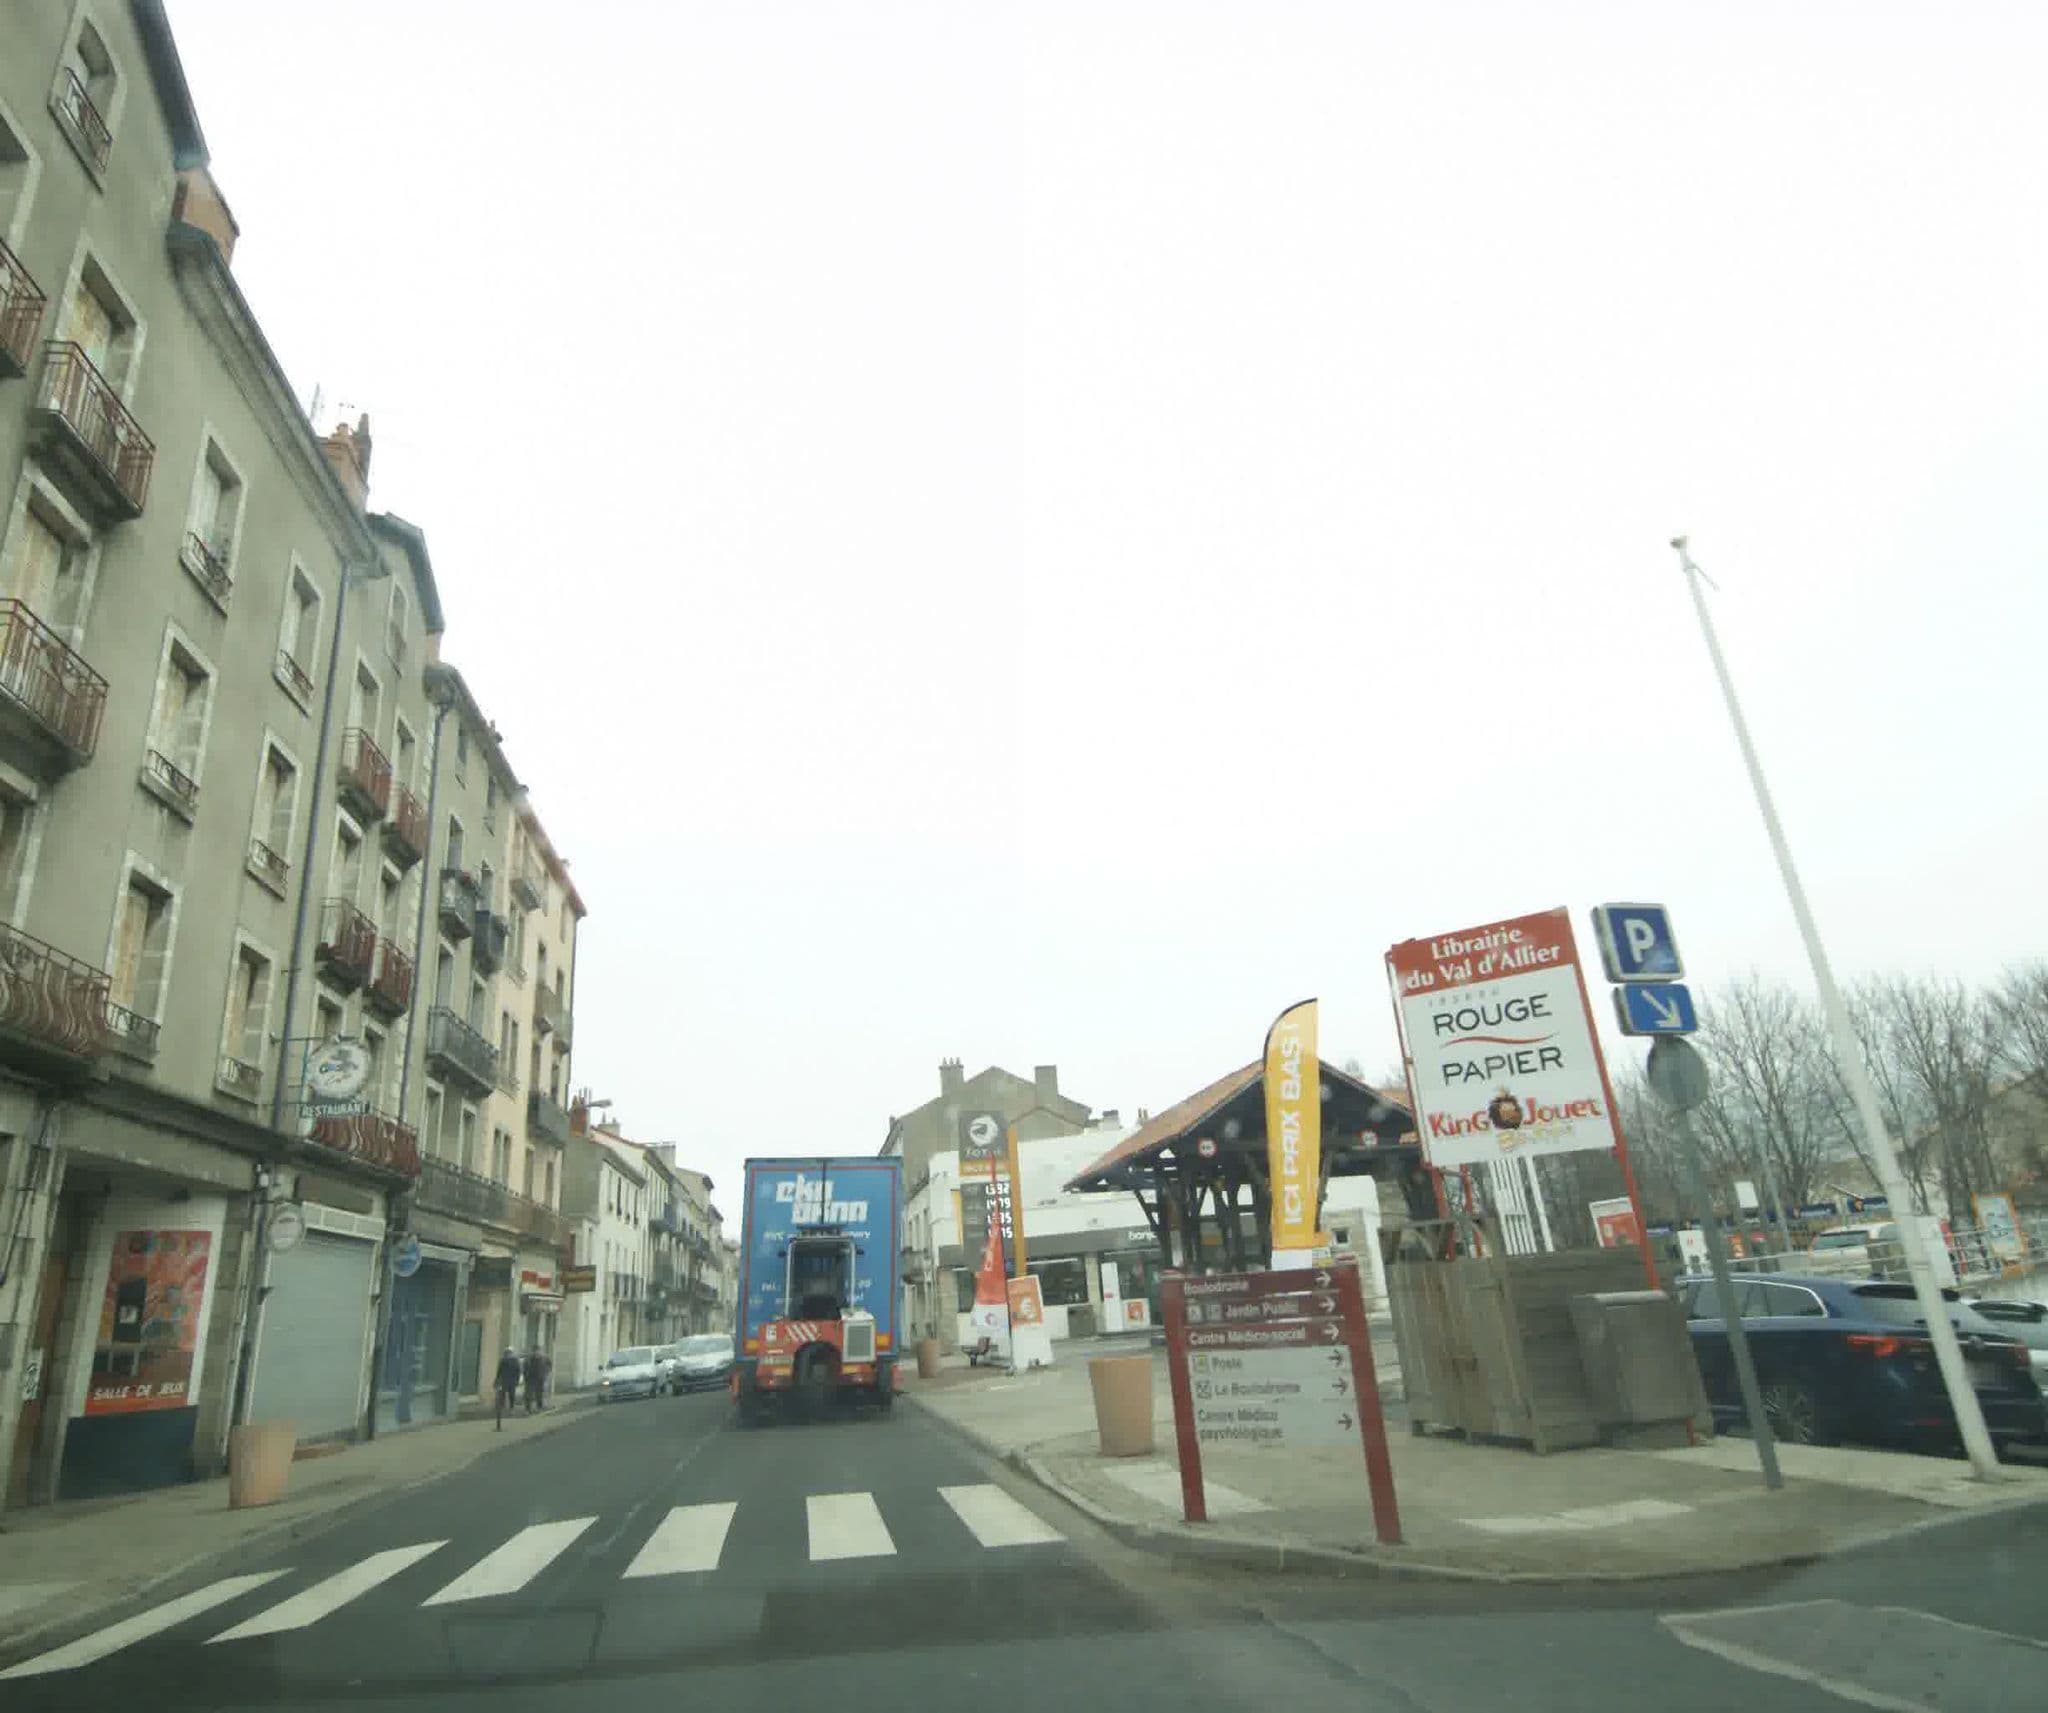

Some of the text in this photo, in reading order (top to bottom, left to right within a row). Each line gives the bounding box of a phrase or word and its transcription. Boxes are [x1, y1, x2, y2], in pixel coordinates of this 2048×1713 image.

[1431, 926, 1523, 960] Librairie
[1625, 919, 1655, 963] P
[1406, 944, 1561, 989] du Val d'Allier
[1432, 994, 1553, 1036] ROUGE
[1442, 1046, 1565, 1086] PAPIER
[302, 1102, 367, 1118] RESTAURANT
[1281, 1110, 1300, 1177] PRIX
[1211, 1357, 1243, 1369] Poste
[93, 1386, 130, 1400] SALLE
[136, 1384, 153, 1398] DE
